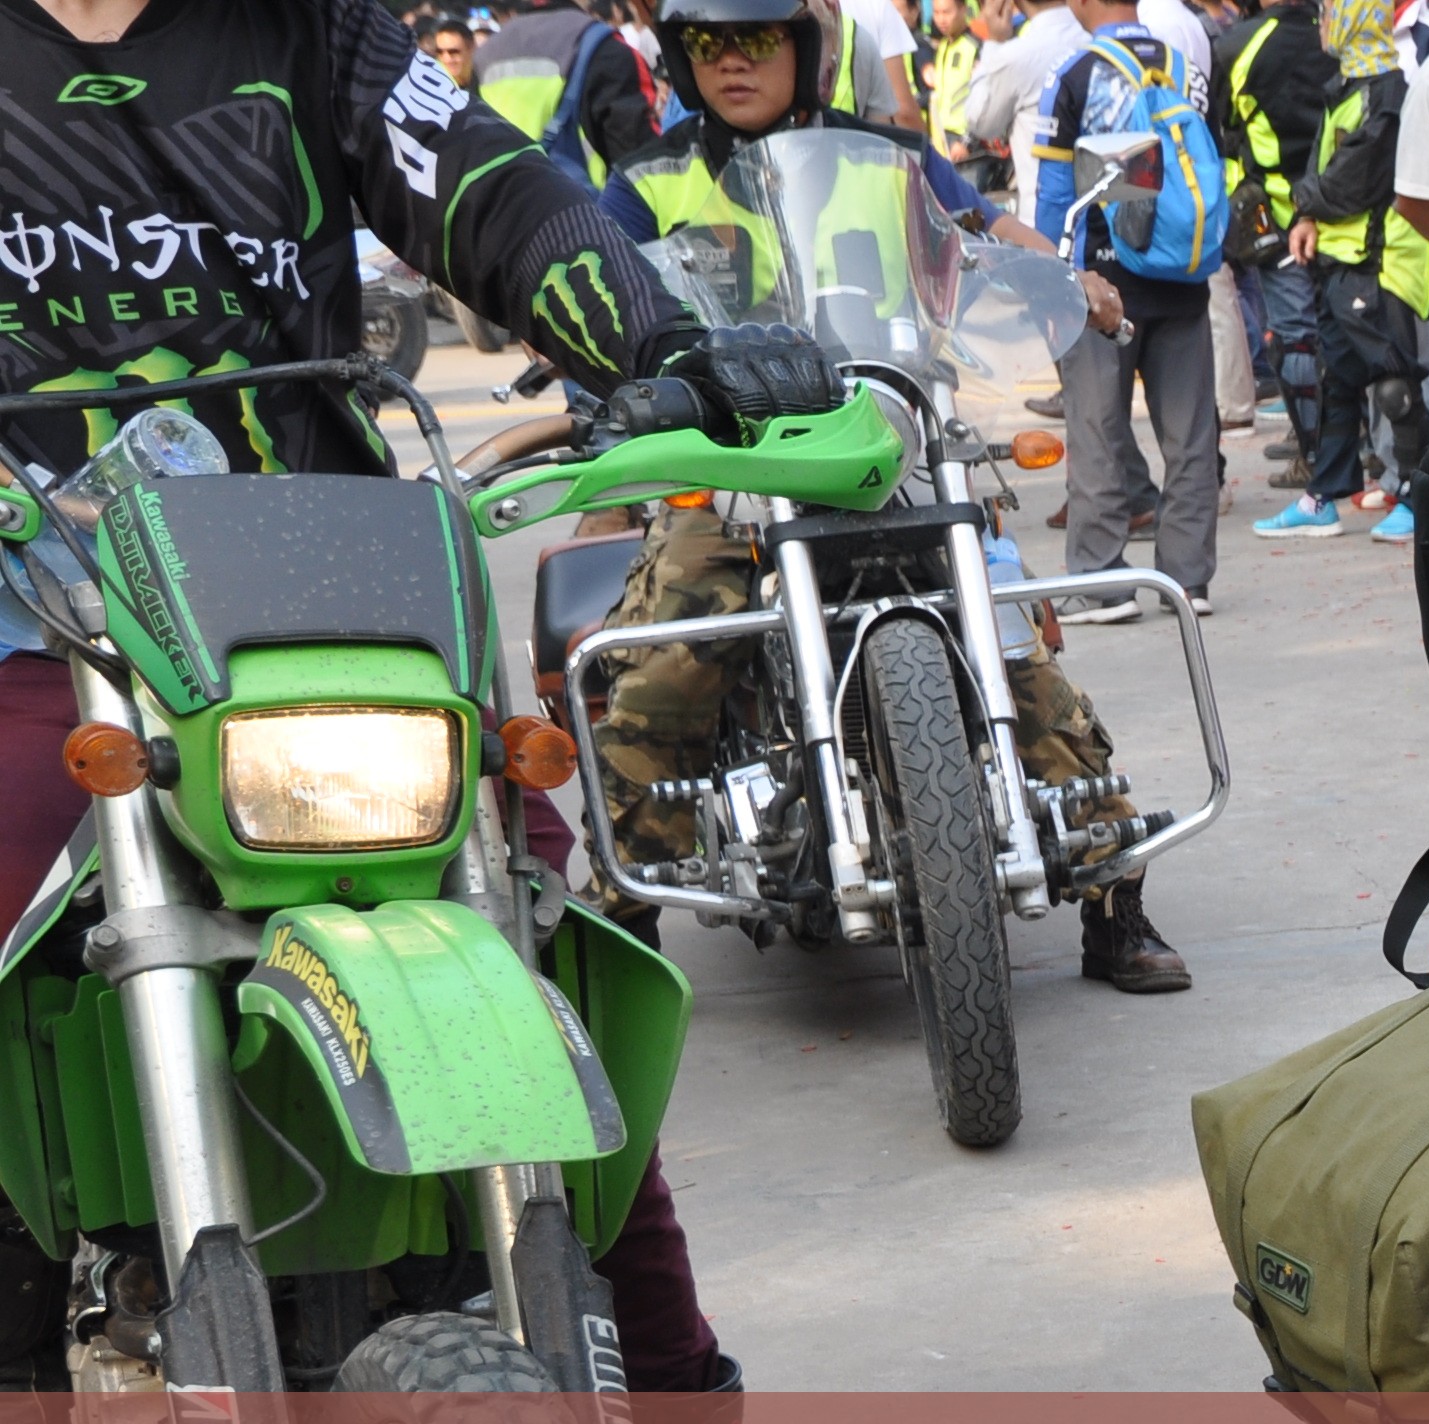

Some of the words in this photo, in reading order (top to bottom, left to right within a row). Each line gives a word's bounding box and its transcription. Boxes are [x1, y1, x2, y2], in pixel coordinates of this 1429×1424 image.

[0, 287, 262, 332] ENERG
[140, 491, 191, 583] Kawasaki
[265, 924, 370, 1080] Kawasaki
[300, 996, 332, 1038] KAWASAKI
[324, 1036, 356, 1086] KLX250ES
